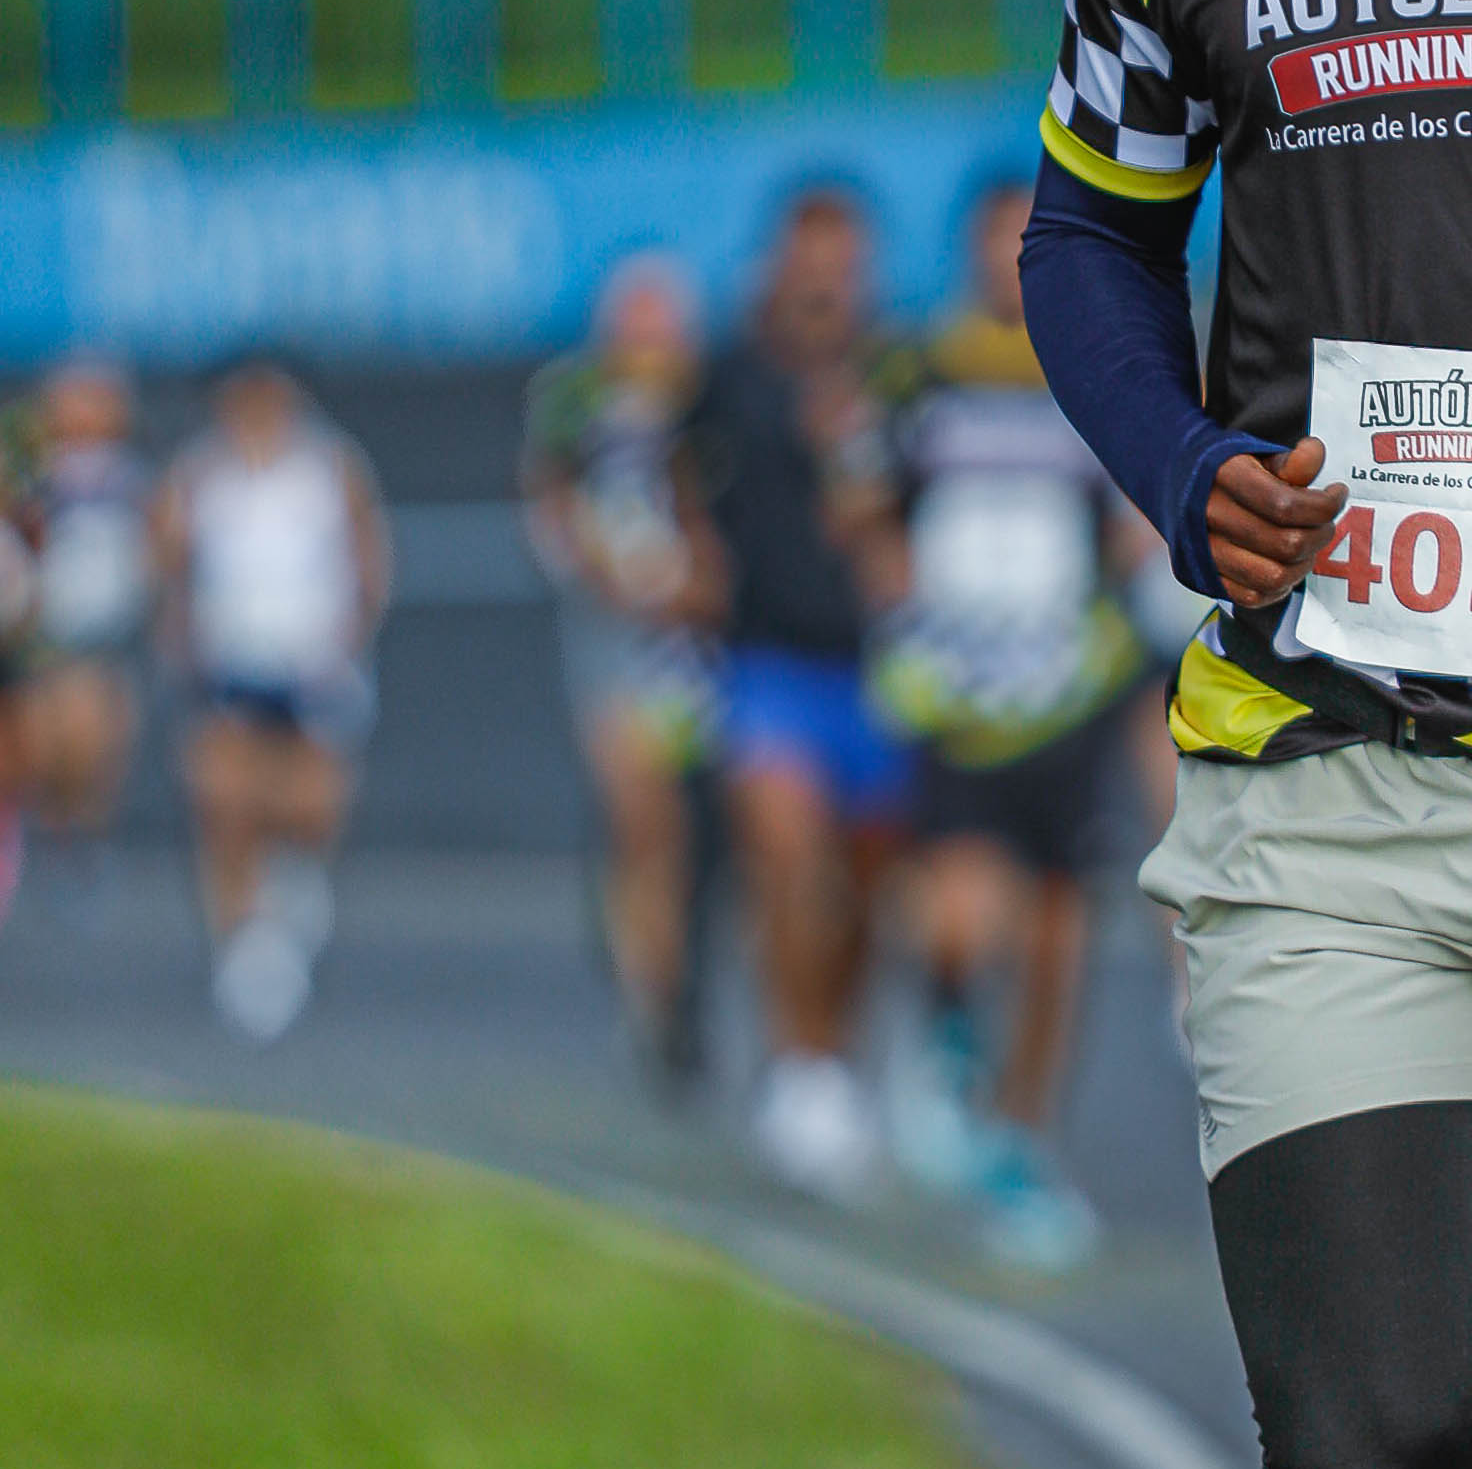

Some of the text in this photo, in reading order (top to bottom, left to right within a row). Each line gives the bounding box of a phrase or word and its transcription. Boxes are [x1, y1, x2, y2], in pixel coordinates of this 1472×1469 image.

[1265, 127, 1282, 150] La
[1283, 124, 1365, 149] Carrera
[1371, 113, 1404, 141] de
[1410, 111, 1449, 138] los
[1351, 465, 1367, 480] La
[1369, 467, 1420, 485] Carrera
[1422, 472, 1440, 486] de
[1443, 473, 1463, 488] los
